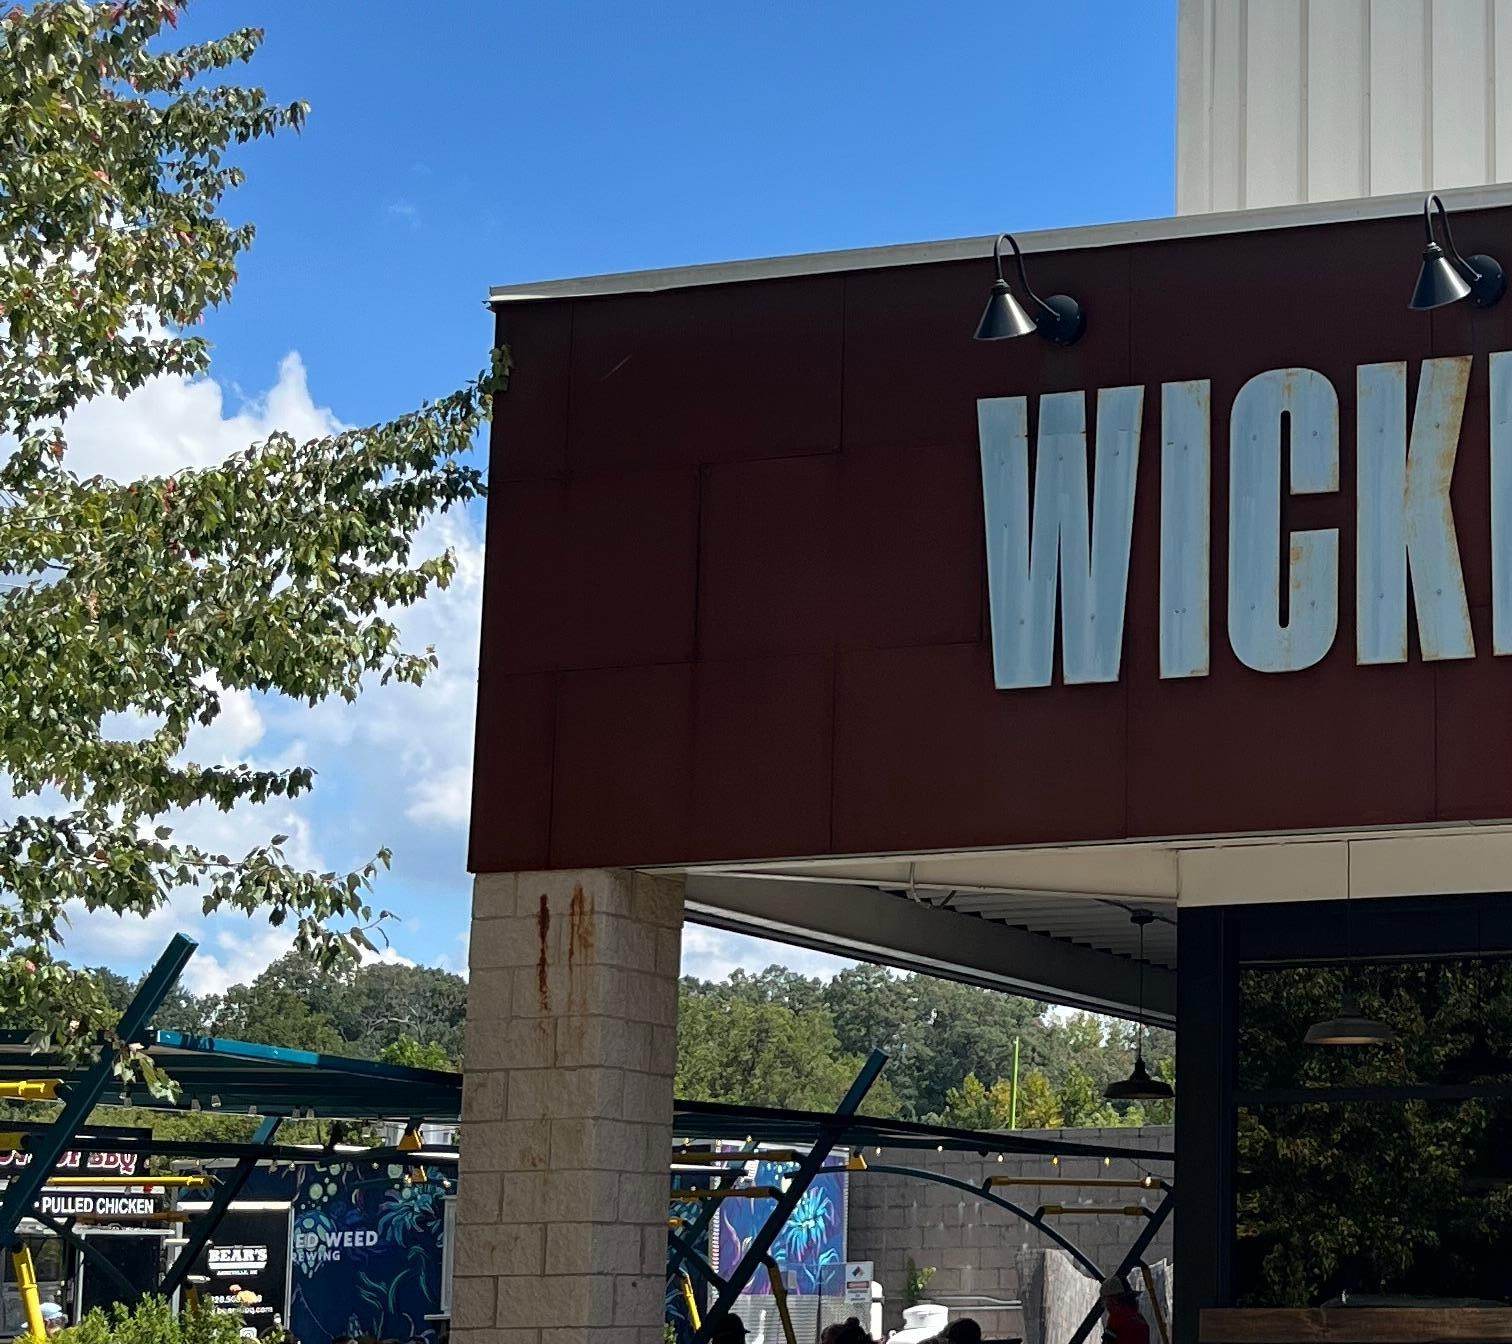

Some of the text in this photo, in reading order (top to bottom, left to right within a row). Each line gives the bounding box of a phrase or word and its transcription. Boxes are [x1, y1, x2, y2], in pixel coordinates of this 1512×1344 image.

[42, 1197, 154, 1215] PULLED CHICKEN
[324, 1229, 379, 1248] WEED
[208, 1247, 268, 1262] BEAR'S
